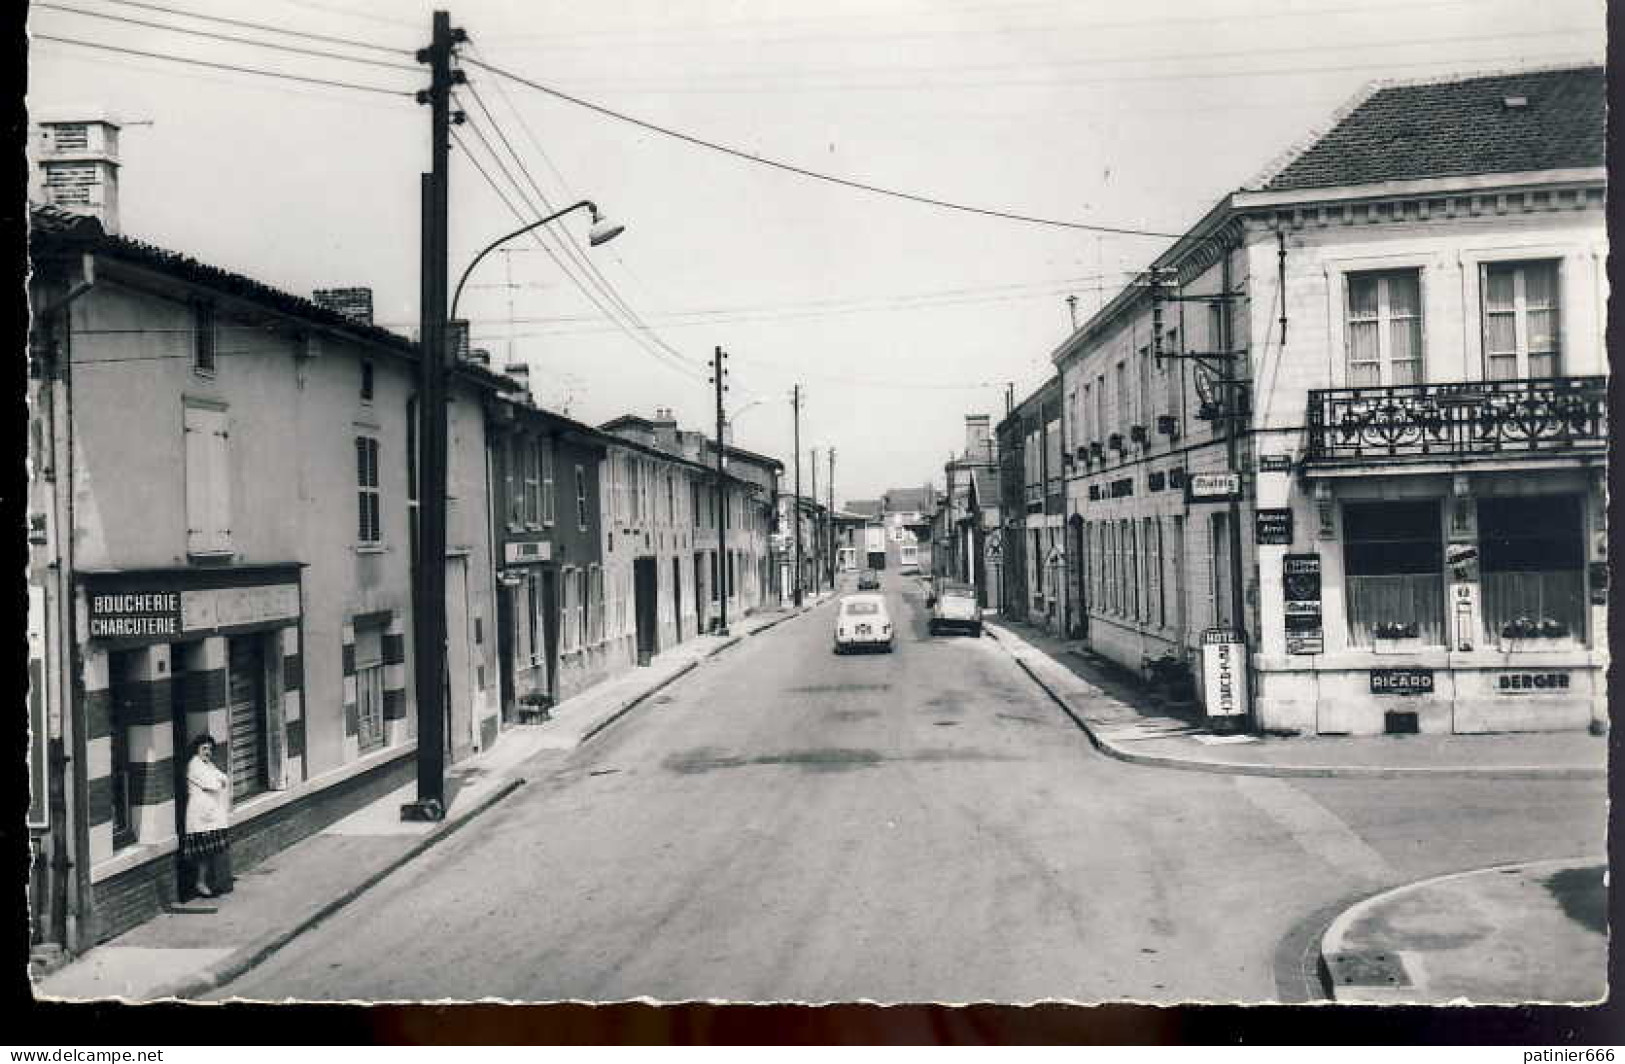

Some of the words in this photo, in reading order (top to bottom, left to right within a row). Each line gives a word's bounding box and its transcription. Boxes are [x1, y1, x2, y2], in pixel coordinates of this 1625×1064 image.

[94, 594, 179, 613] BOUCHERIE
[91, 617, 178, 635] CHARCUTERIE
[1373, 675, 1432, 688] RICARD
[1499, 673, 1570, 690] BERGER
